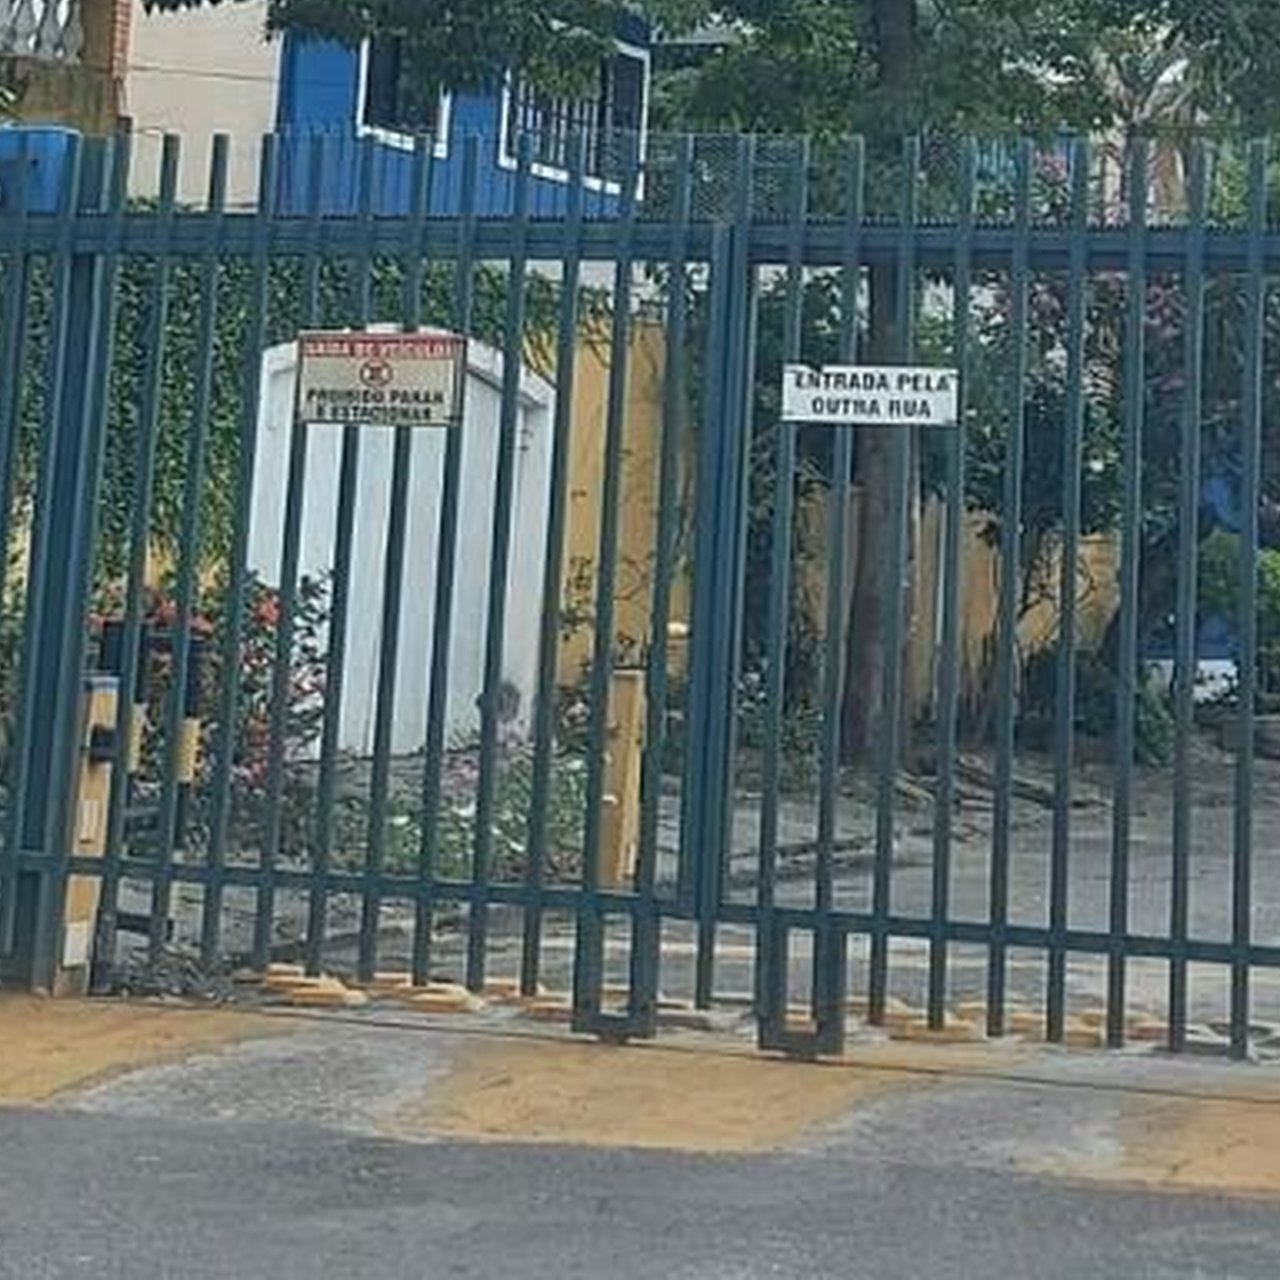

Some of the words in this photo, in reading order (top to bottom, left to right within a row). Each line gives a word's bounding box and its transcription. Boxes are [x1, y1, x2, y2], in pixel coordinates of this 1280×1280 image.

[794, 372, 889, 392] ENTRADA
[897, 373, 951, 393] PELA
[811, 396, 881, 416] OUTRA
[888, 398, 932, 418] RUA
